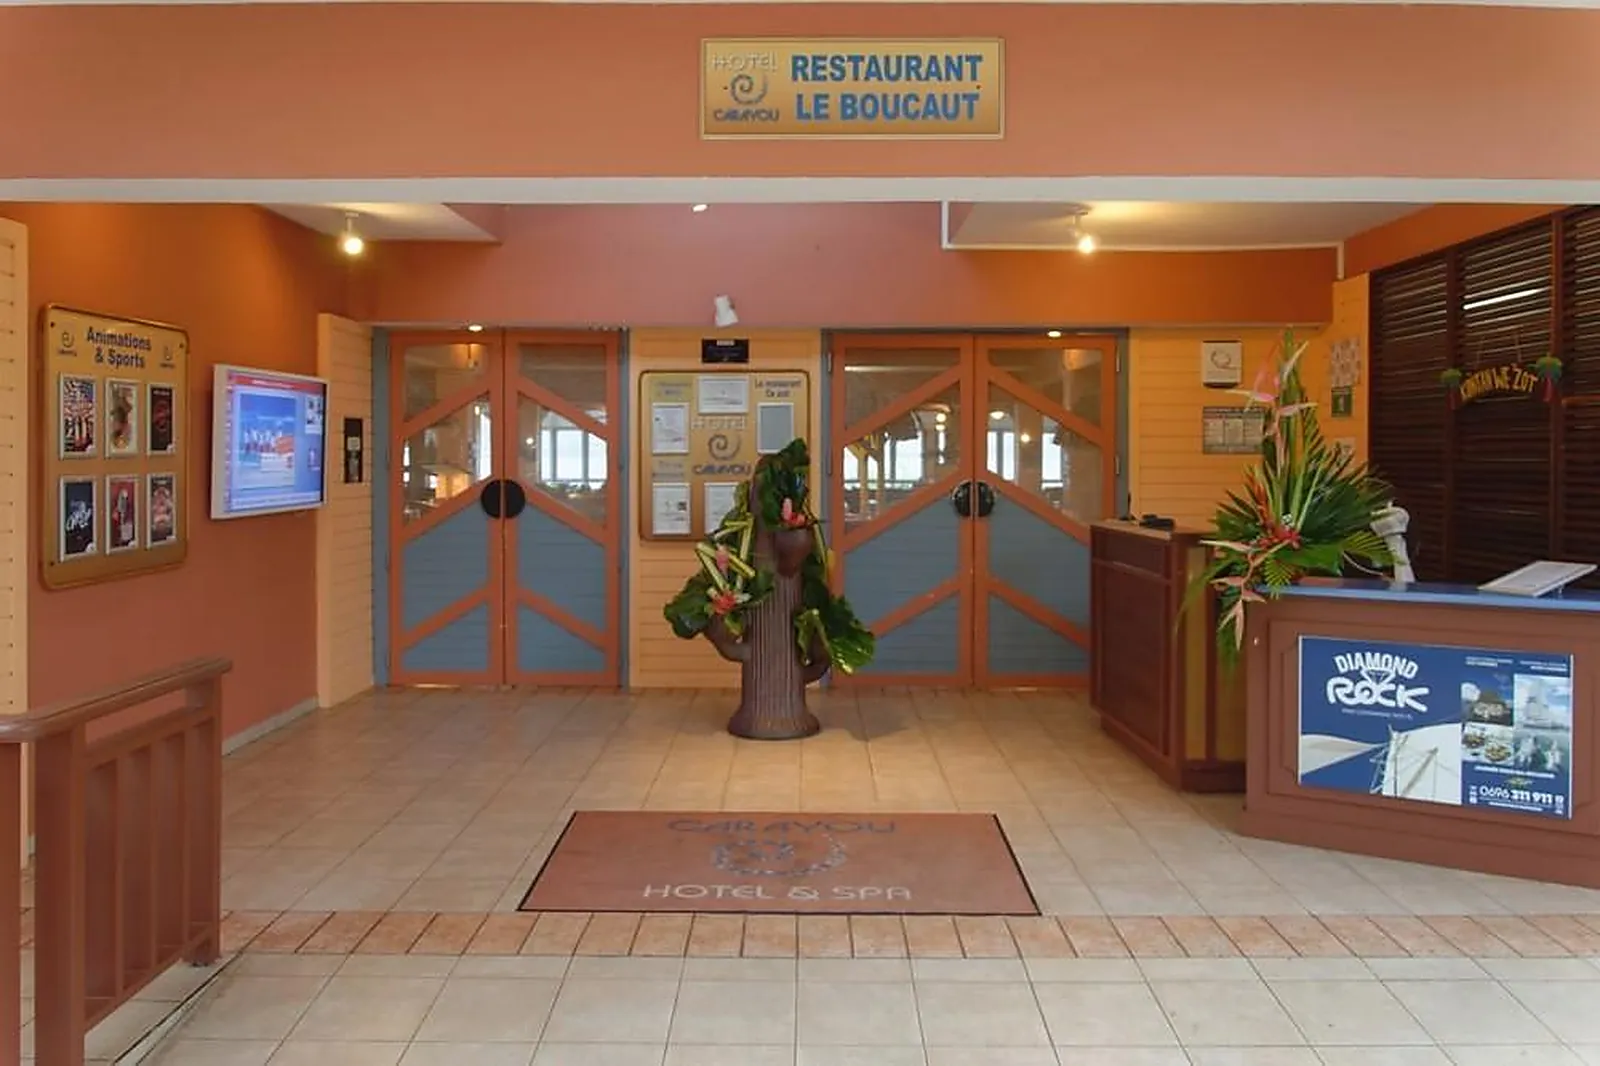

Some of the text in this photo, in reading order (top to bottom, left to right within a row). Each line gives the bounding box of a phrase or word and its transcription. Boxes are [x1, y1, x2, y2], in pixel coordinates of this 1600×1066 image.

[712, 51, 778, 71] HOTEL
[791, 54, 983, 82] RESTAURANT
[713, 108, 779, 122] CARAYOU
[796, 93, 979, 121] LE BOUCAUT
[87, 326, 151, 352] Animations
[95, 346, 104, 363] &
[107, 348, 145, 369] Sports
[1333, 651, 1419, 679] DIAMOND
[1326, 676, 1430, 712] ROCK
[1480, 785, 1510, 799] 0696
[667, 819, 896, 834] CARAYOU
[643, 884, 912, 900] HOTEL & SPA
